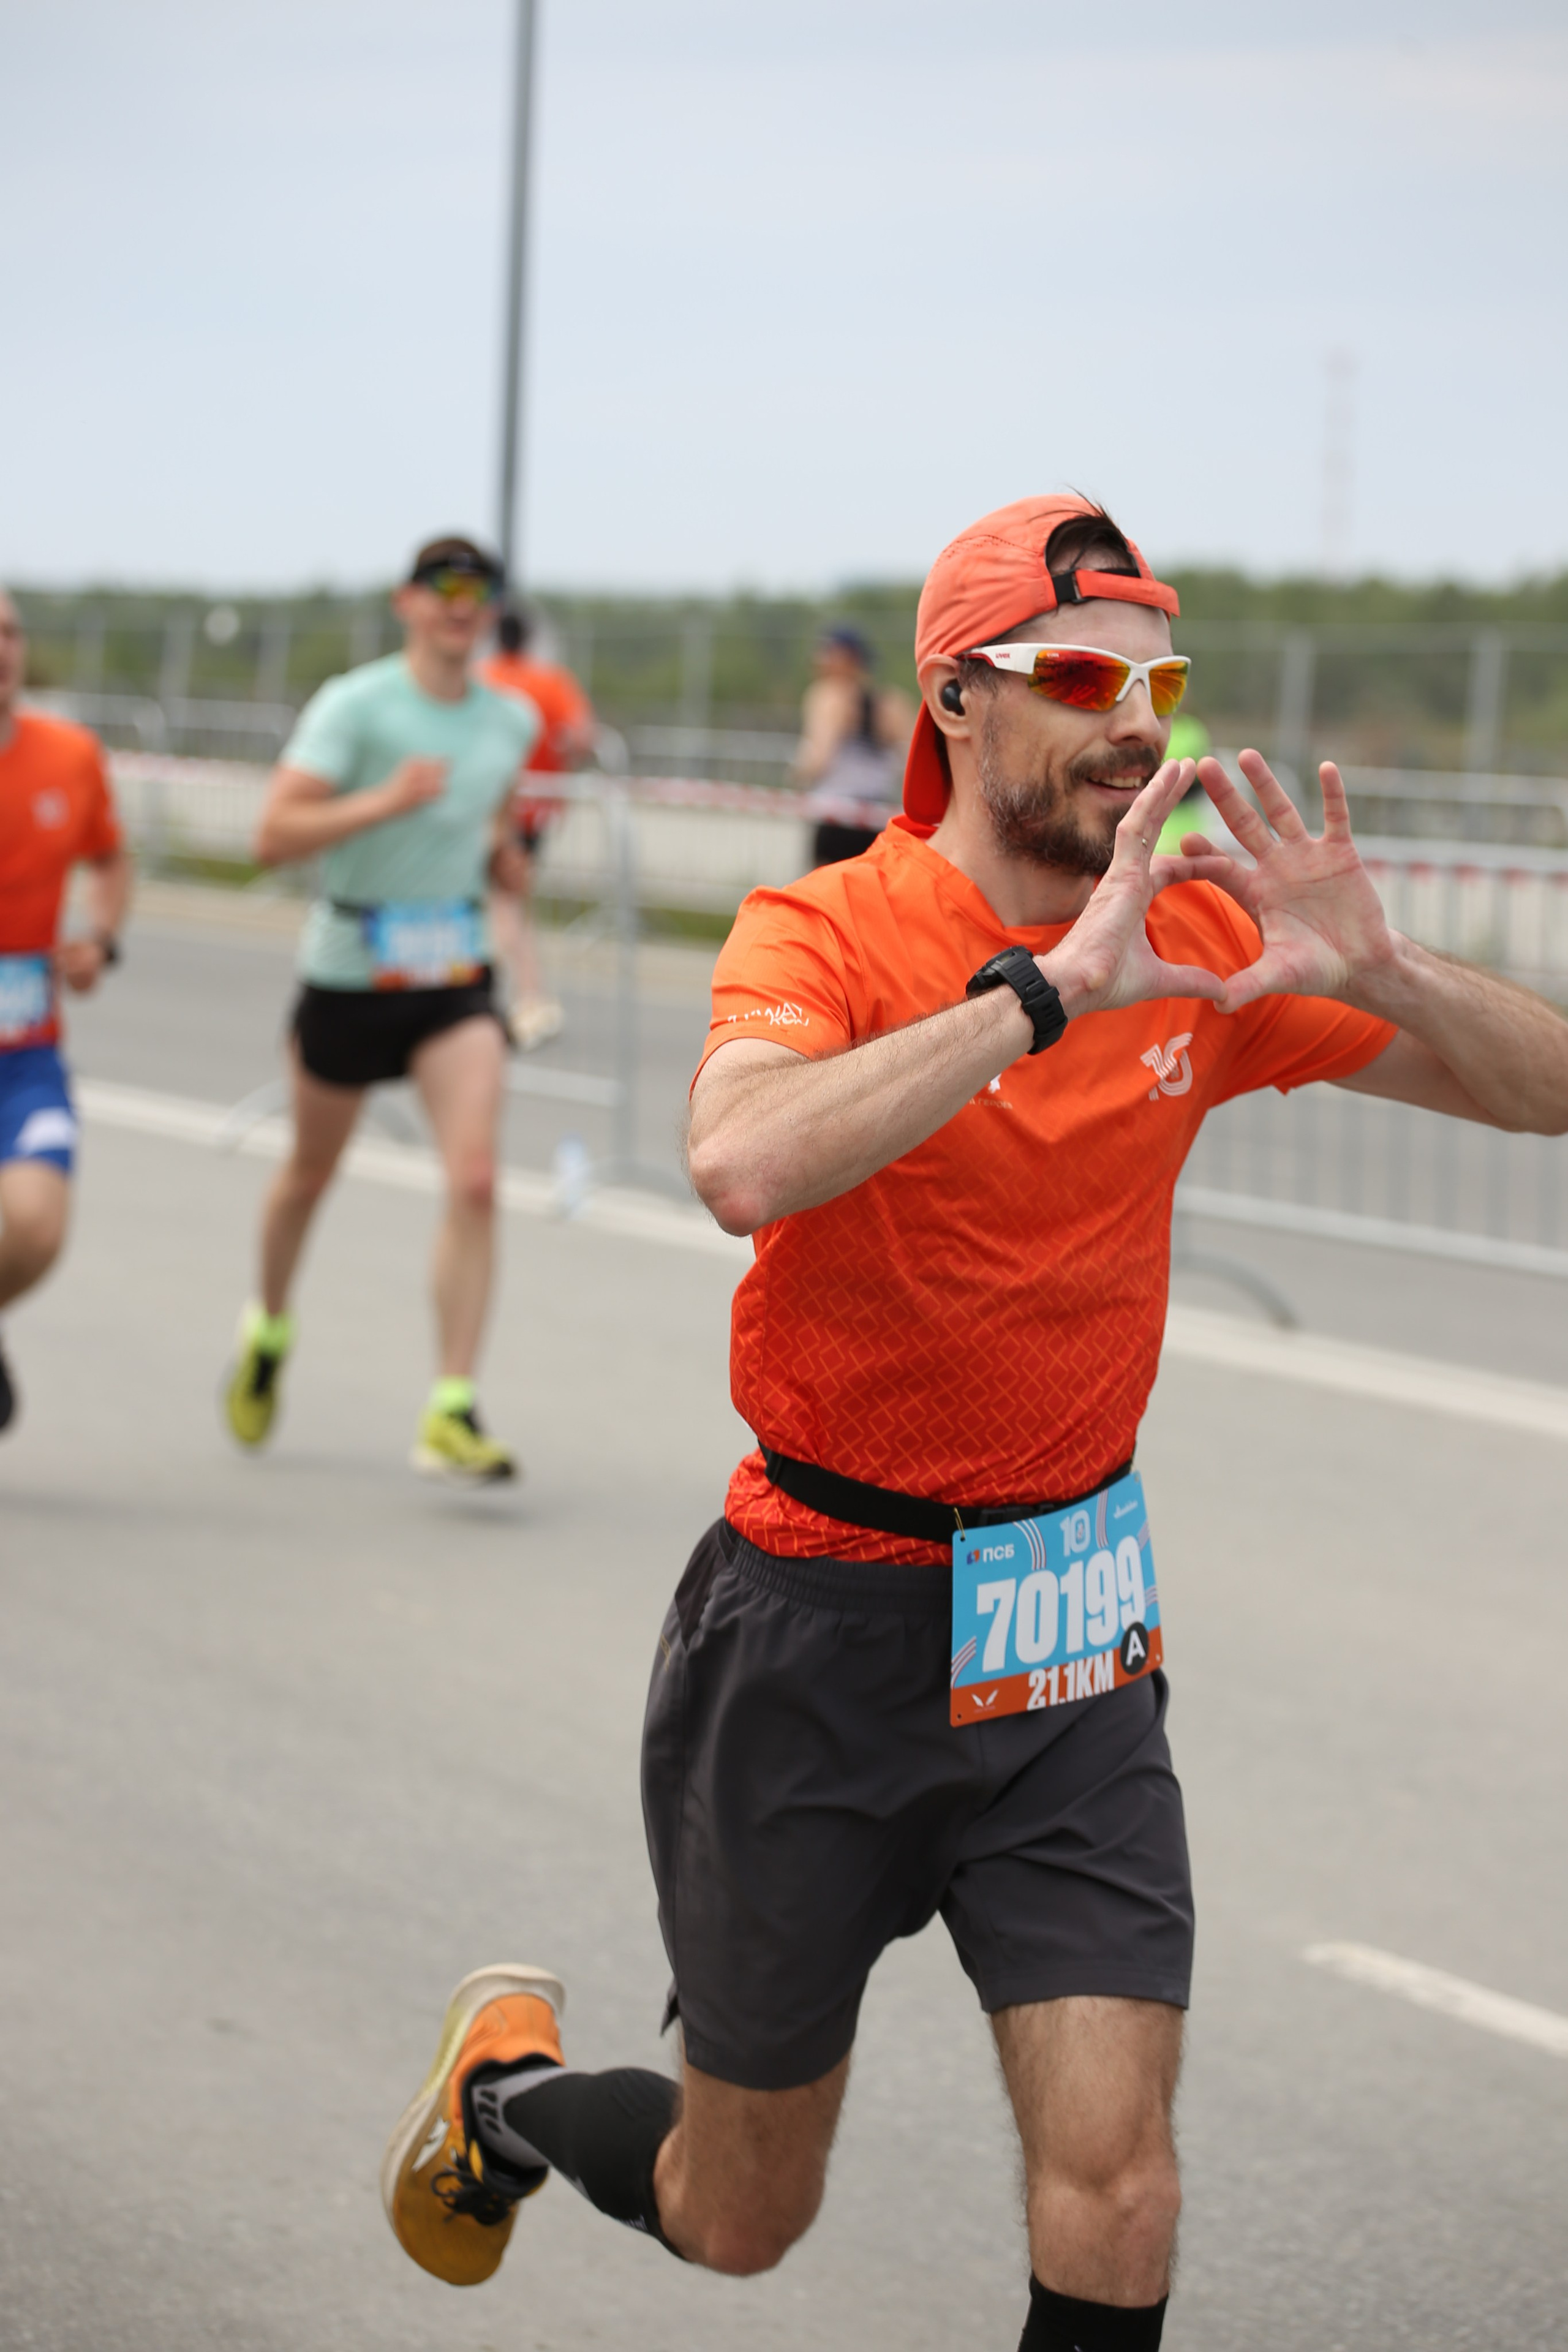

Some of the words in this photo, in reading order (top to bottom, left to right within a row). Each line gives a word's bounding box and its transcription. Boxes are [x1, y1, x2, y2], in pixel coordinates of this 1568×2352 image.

[982, 1544, 1016, 1563] ПСБ
[1059, 1509, 1091, 1558] 10
[976, 1535, 1146, 1673] 70199
[1126, 1629, 1146, 1667] A
